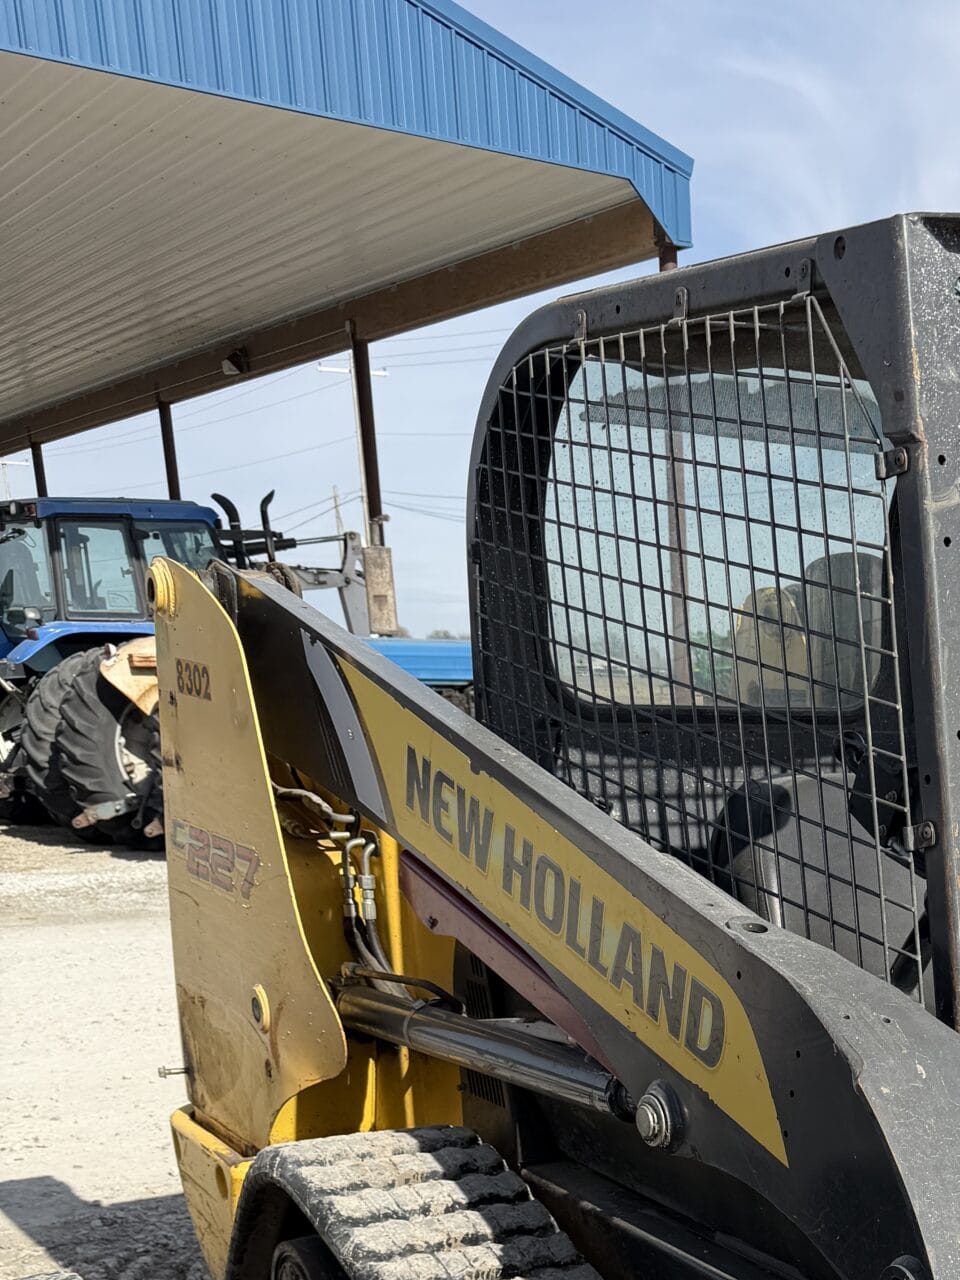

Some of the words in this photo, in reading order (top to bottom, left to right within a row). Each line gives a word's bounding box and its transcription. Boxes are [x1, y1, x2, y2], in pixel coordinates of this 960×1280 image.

[176, 658, 212, 700] 8302
[405, 744, 494, 874] NEW
[502, 824, 726, 1069] HOLLAND
